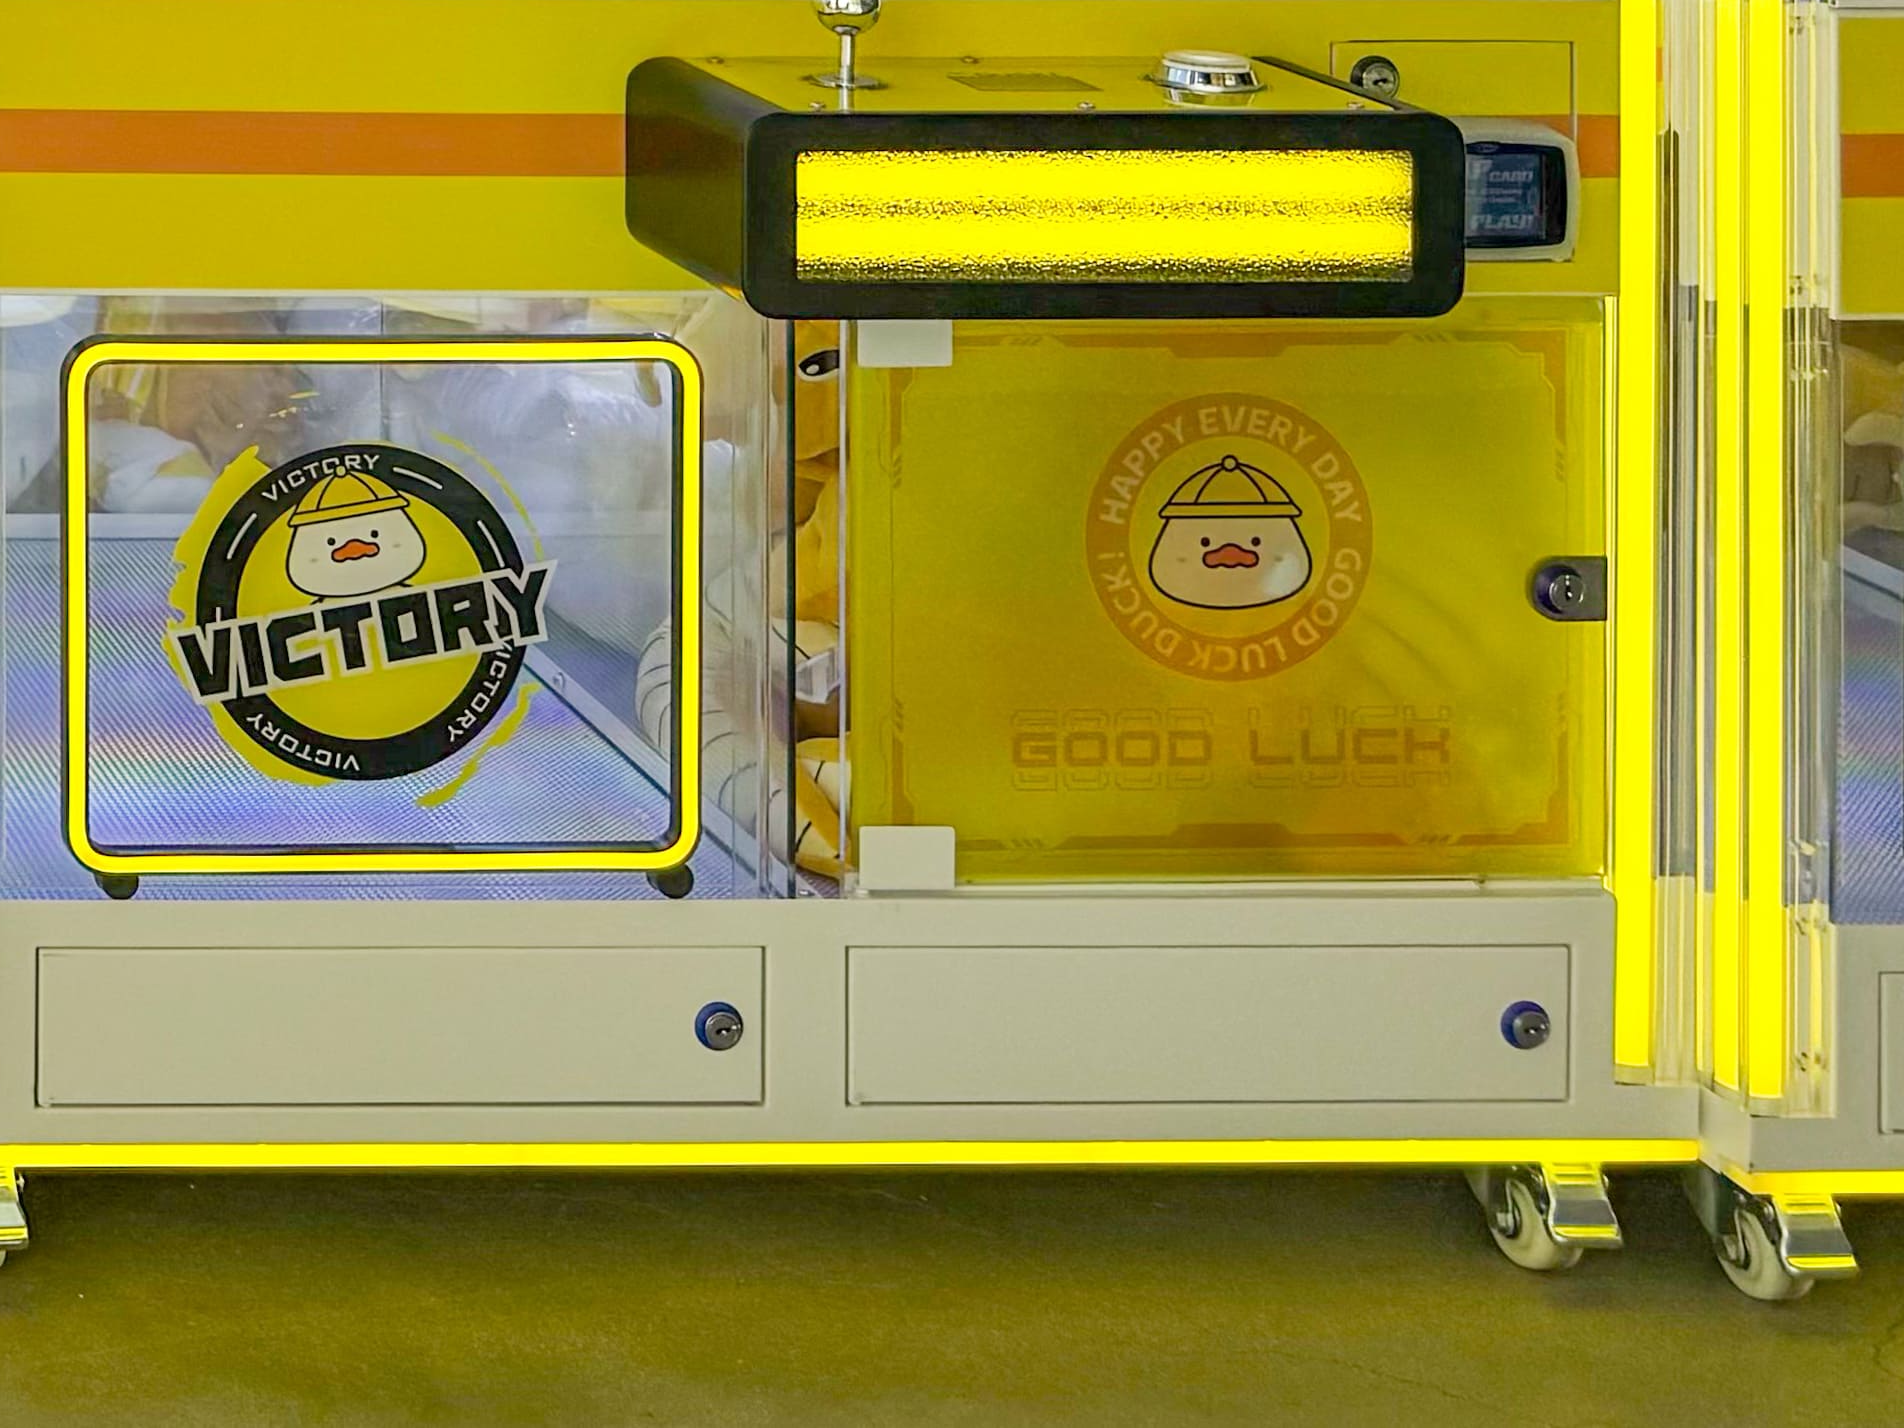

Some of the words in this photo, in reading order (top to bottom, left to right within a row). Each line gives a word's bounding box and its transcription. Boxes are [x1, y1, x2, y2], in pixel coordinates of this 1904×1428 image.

[262, 452, 381, 502] VICTORY
[1099, 414, 1185, 525] HAPPY
[1198, 404, 1318, 450] EVERY
[1310, 450, 1364, 524] DAY
[1294, 546, 1363, 649] GOOD
[176, 567, 551, 700] VICTORY
[1190, 634, 1288, 674] LUCK
[245, 711, 360, 773] VICTORY
[1012, 729, 1212, 768] GOOD
